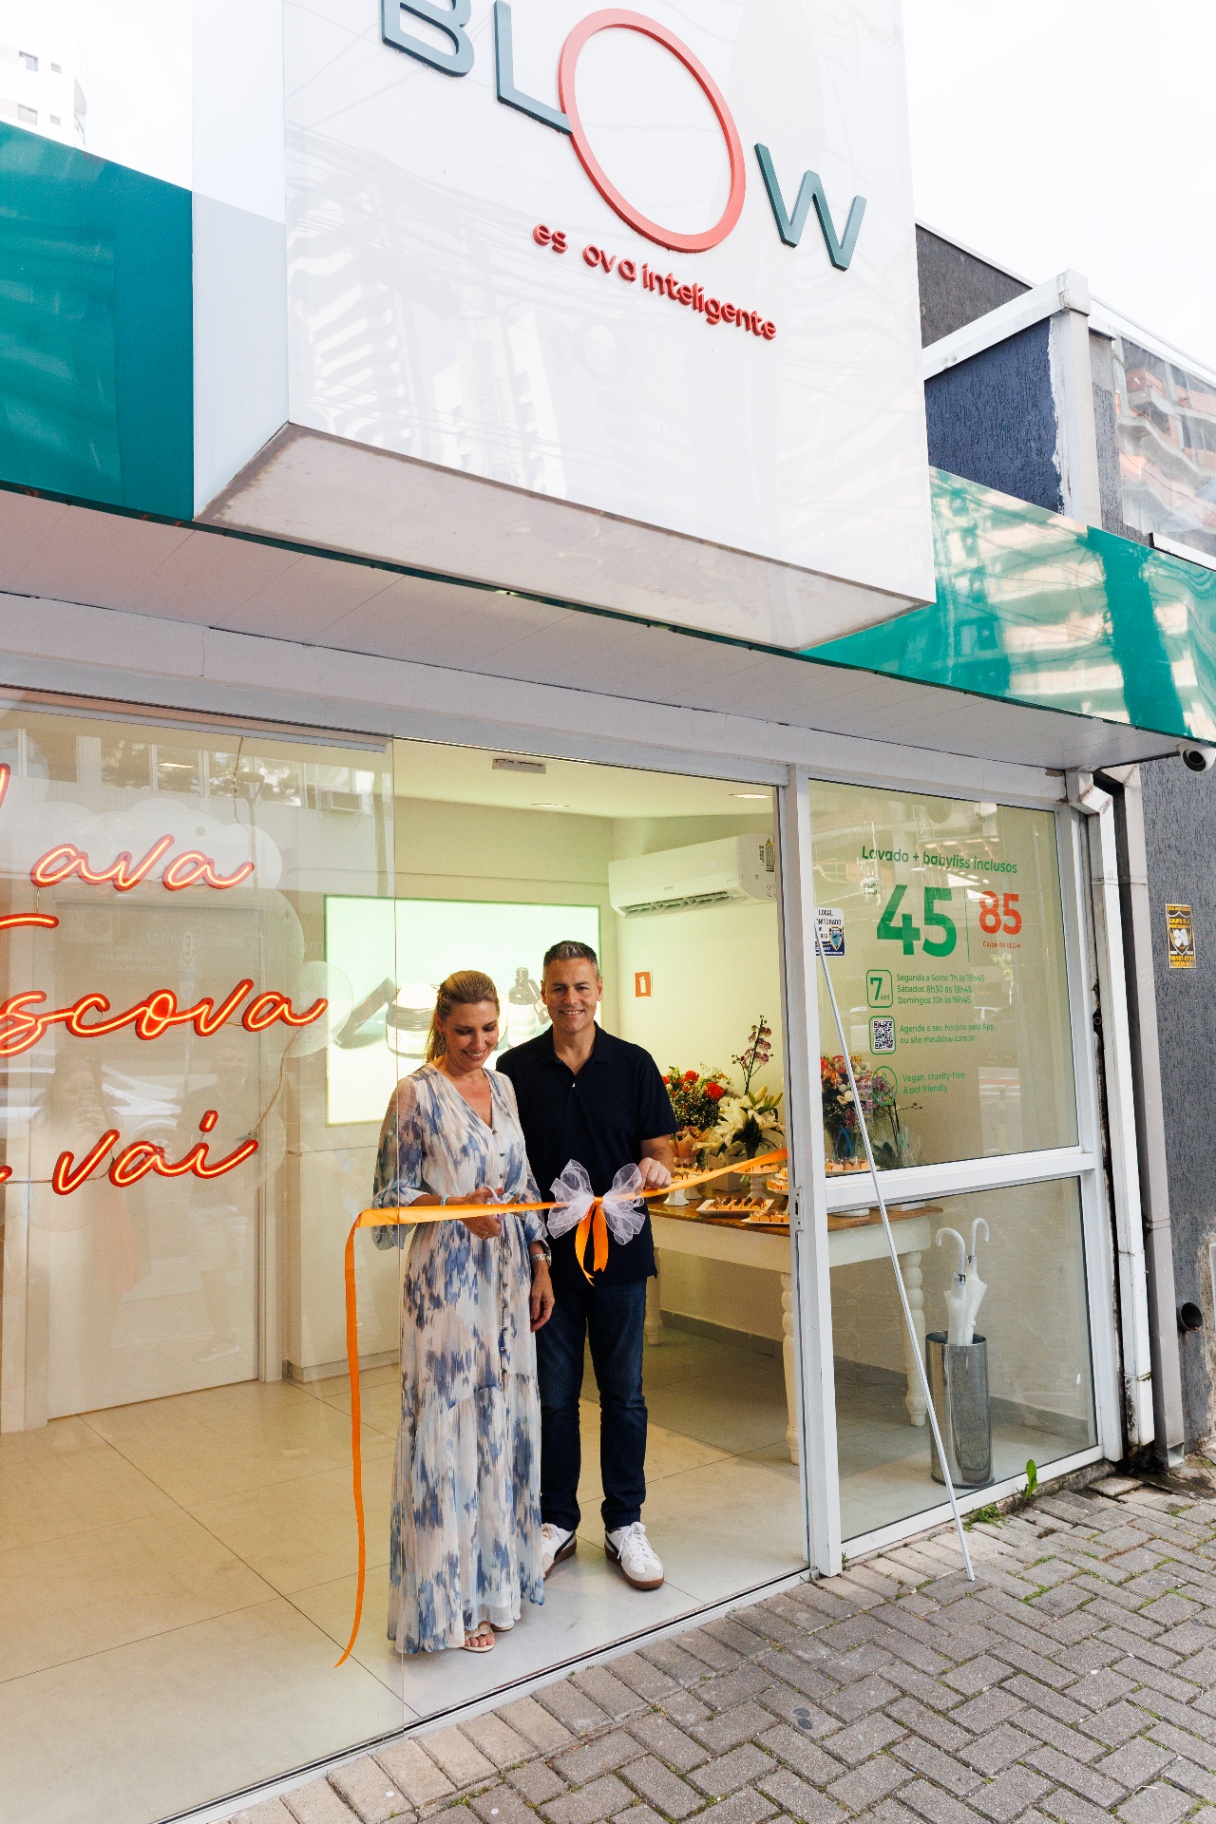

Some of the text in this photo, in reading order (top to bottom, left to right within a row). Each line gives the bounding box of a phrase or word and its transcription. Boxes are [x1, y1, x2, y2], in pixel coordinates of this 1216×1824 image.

[641, 262, 778, 341] inteligente
[861, 845, 909, 863] Lavado
[922, 850, 971, 870] babyliss
[973, 856, 1018, 874] inclusos
[876, 883, 957, 958] 45
[978, 890, 1022, 936] 85
[870, 977, 883, 1001] 7
[52, 1109, 259, 1196] vai
